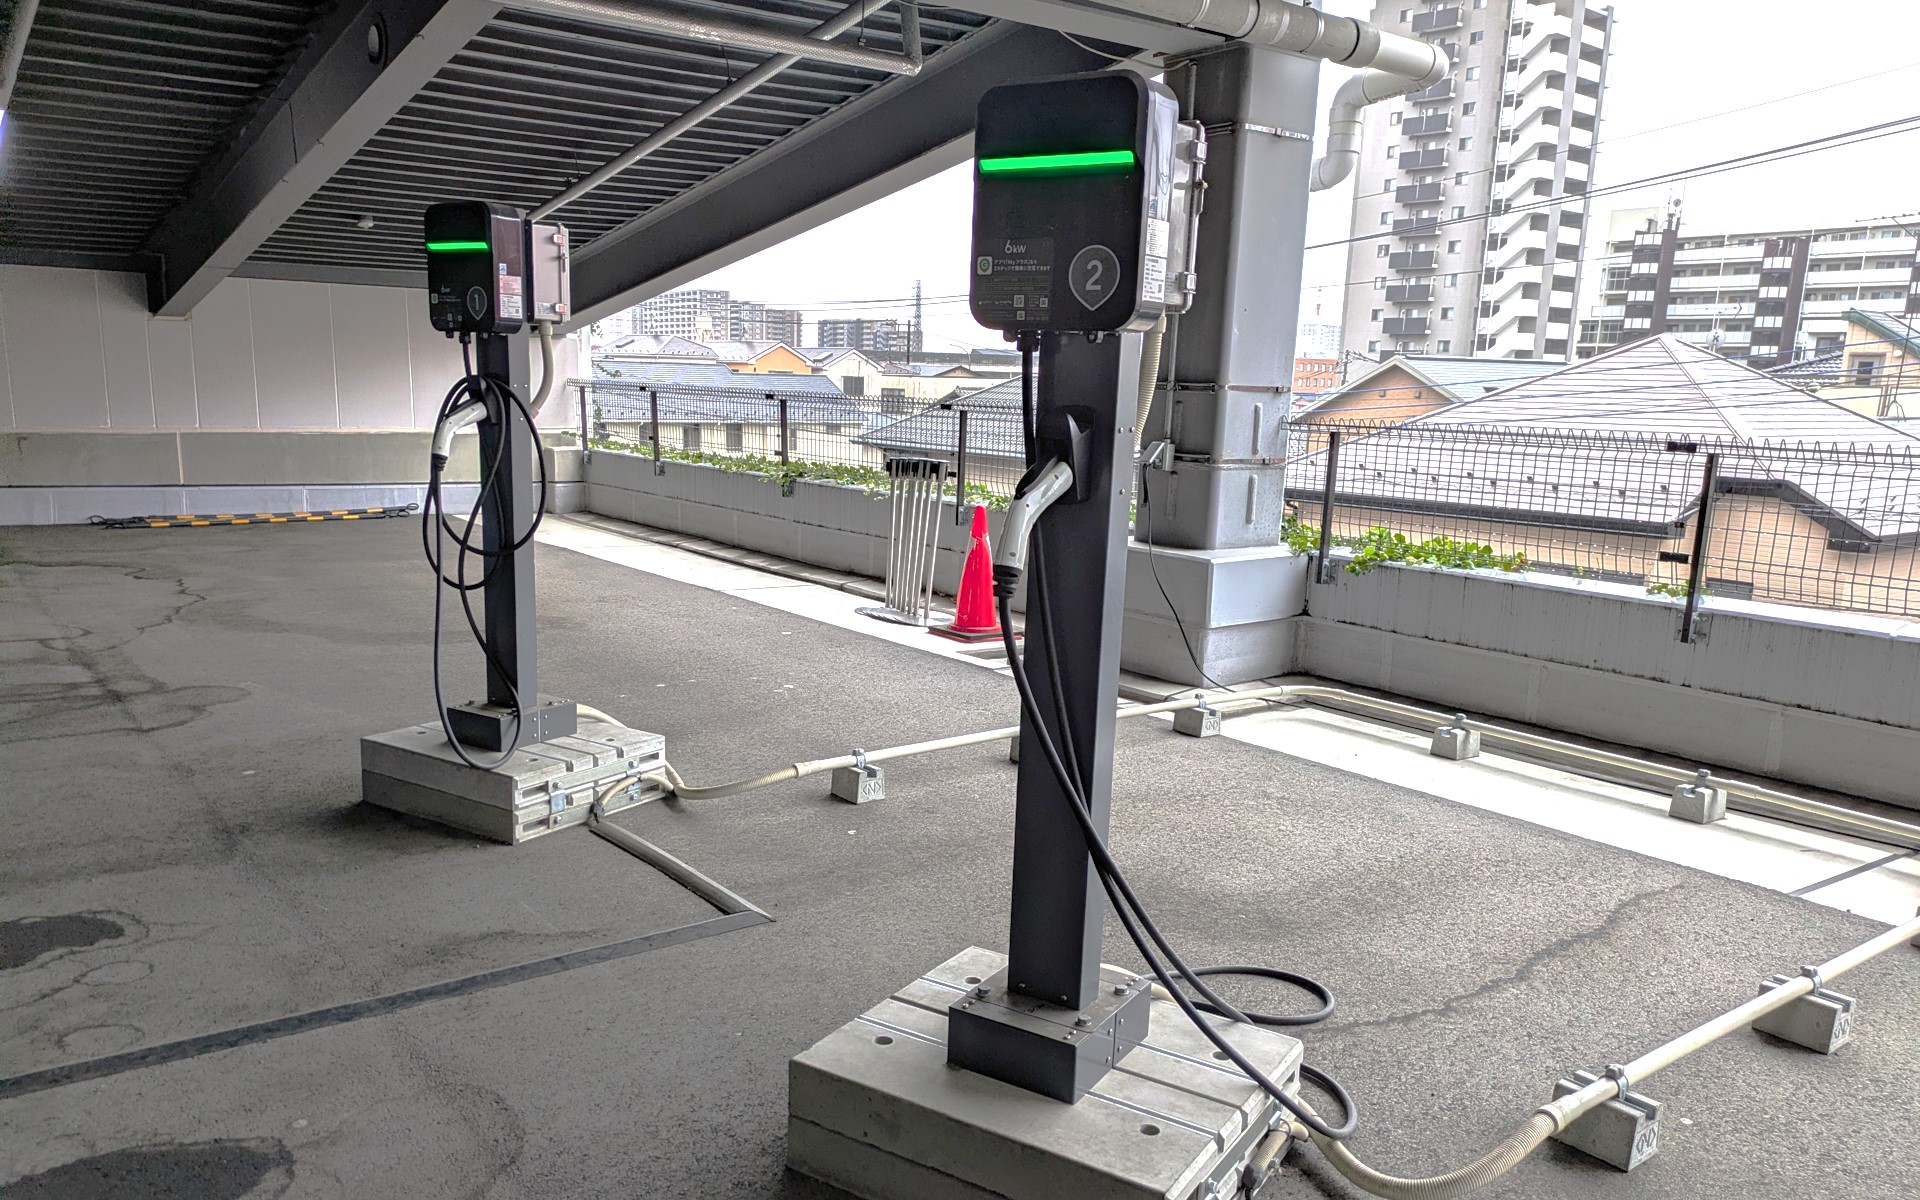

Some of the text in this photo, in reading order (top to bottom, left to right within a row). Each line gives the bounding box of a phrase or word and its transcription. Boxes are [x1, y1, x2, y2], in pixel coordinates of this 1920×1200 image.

[1004, 239, 1027, 254] 6kW
[1085, 259, 1103, 291] 2
[473, 294, 479, 310] 1
